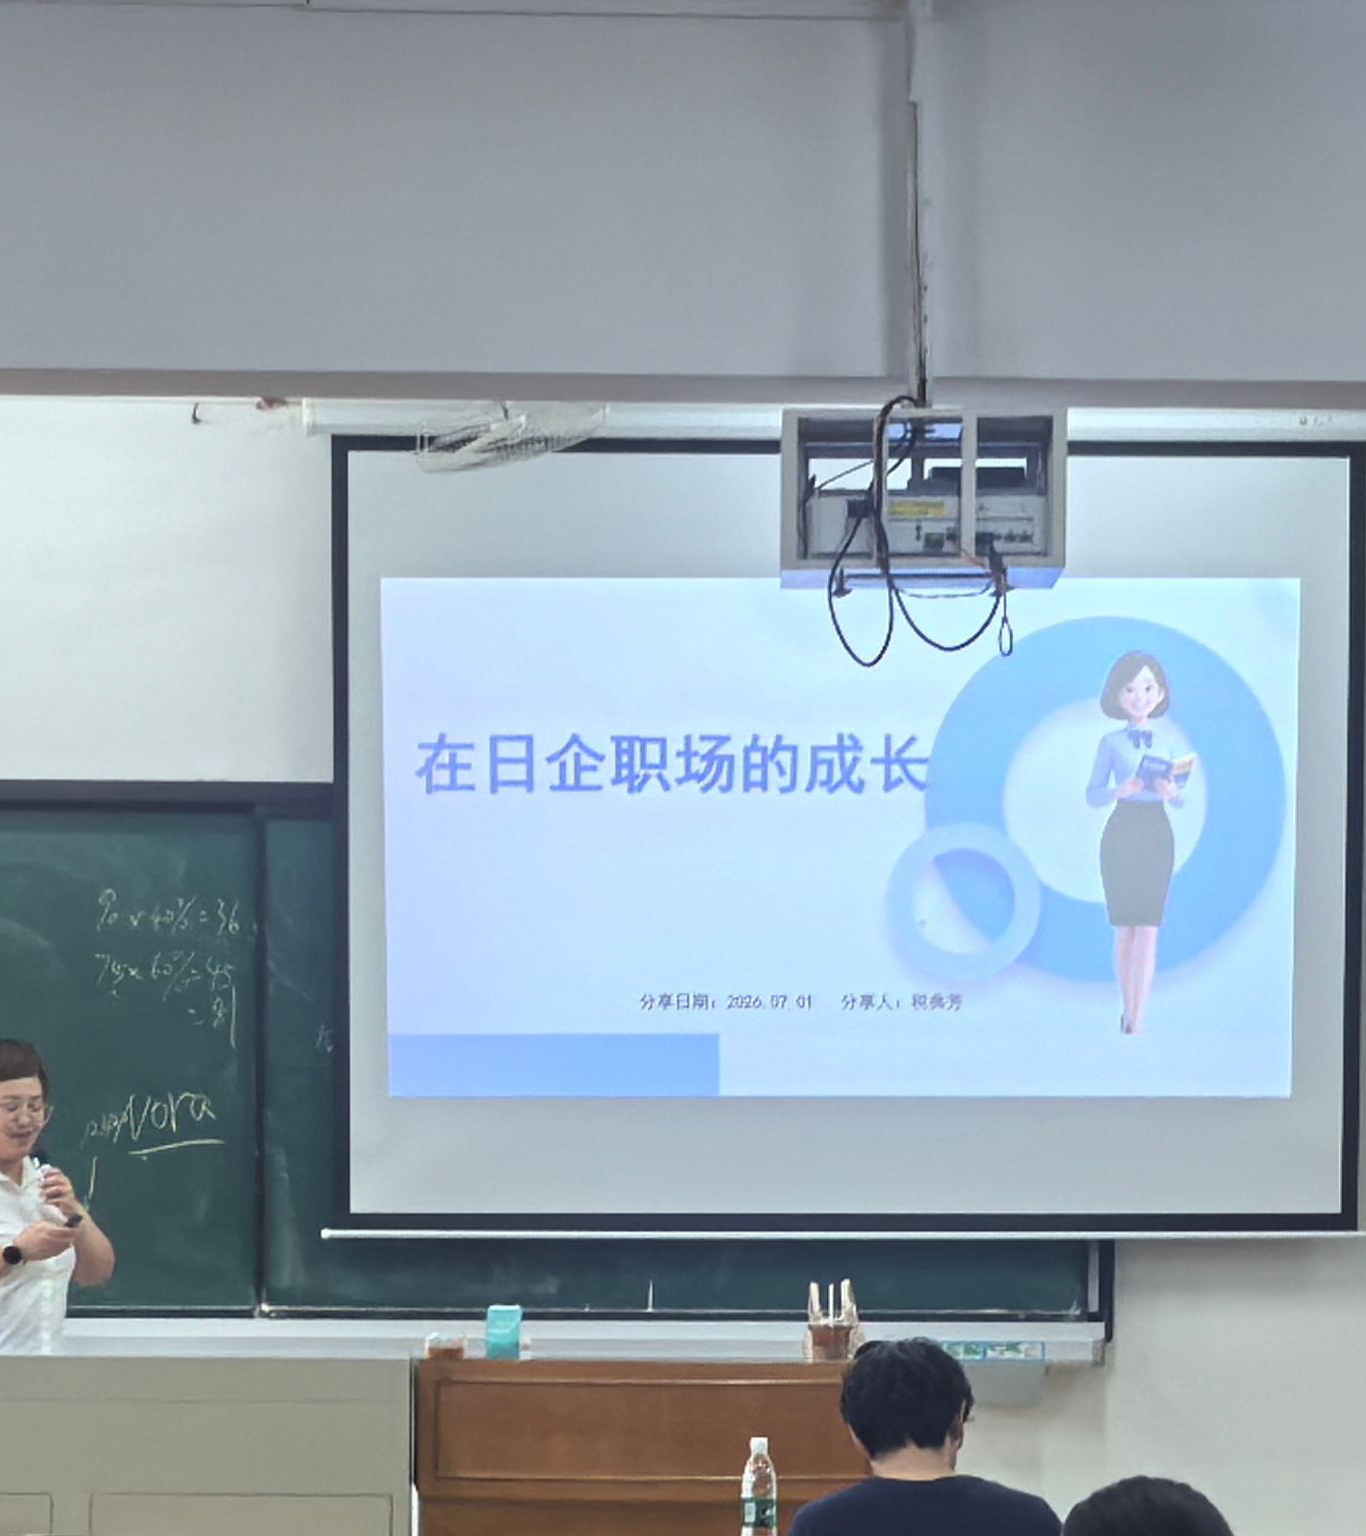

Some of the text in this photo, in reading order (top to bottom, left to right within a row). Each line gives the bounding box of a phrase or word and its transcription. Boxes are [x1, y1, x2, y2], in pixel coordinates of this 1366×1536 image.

[414, 732, 930, 795] 在日企职场的成长
